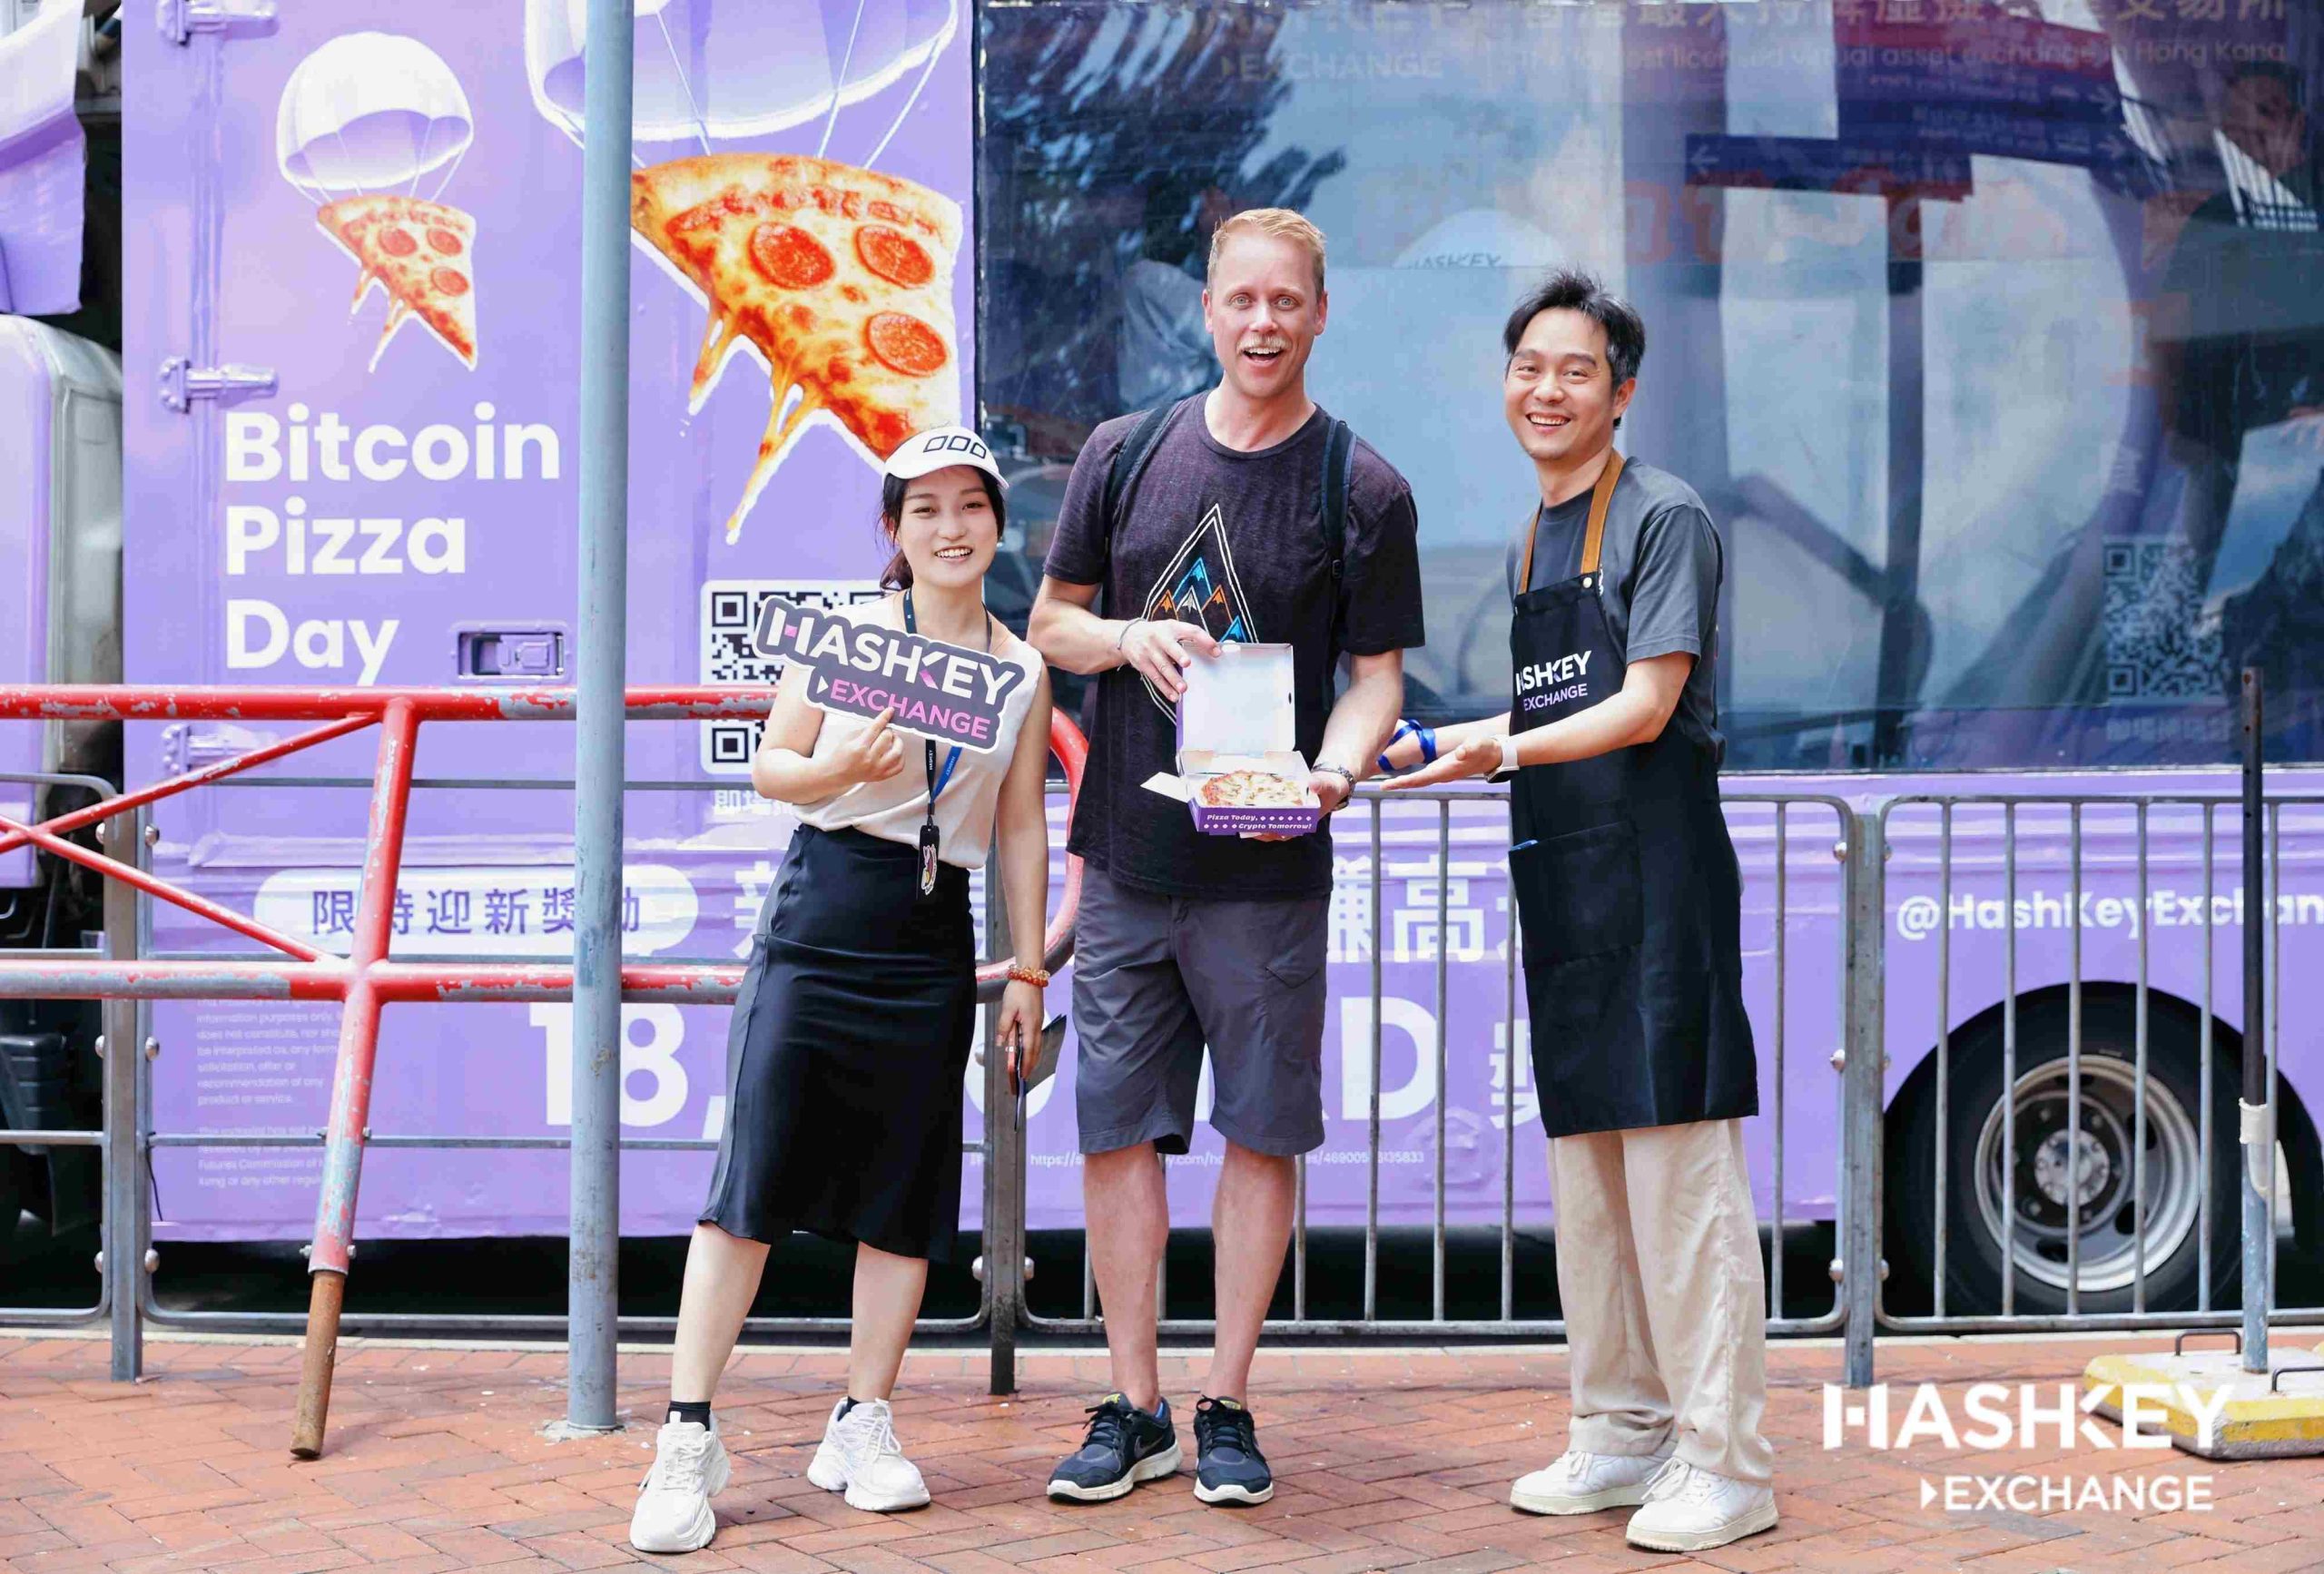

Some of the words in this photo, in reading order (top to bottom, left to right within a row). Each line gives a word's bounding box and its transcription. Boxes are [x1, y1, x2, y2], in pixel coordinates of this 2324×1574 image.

[226, 402, 560, 481] Bitcoin
[226, 497, 466, 574] Pizza
[226, 599, 399, 686] Day
[766, 607, 1015, 705] HASHKEY
[830, 678, 991, 740] EXCHANGE
[1523, 683, 1589, 712] EXCHANGE
[1238, 822, 1267, 831] Crypto
